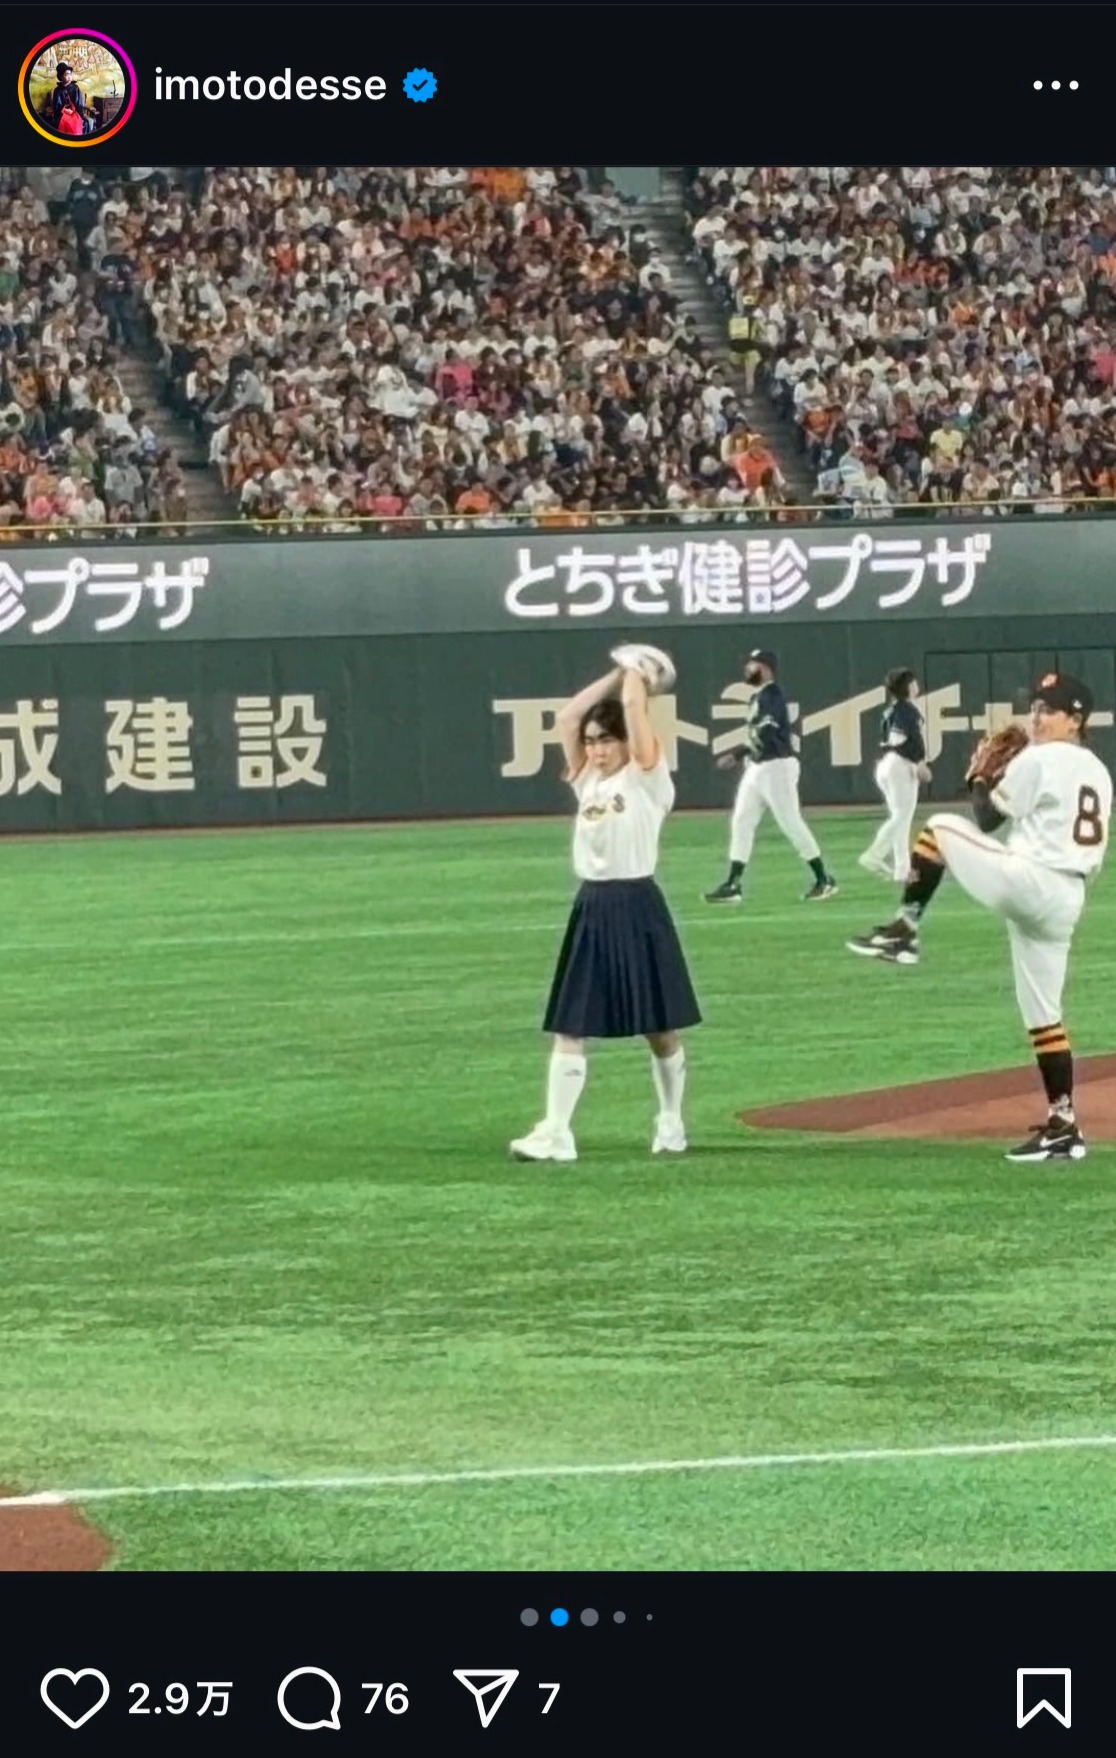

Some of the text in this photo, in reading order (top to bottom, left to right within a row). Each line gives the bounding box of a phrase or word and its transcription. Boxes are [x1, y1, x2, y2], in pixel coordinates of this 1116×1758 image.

[504, 535, 992, 617] とちぎ健診プラザ
[1073, 785, 1103, 846] 8
